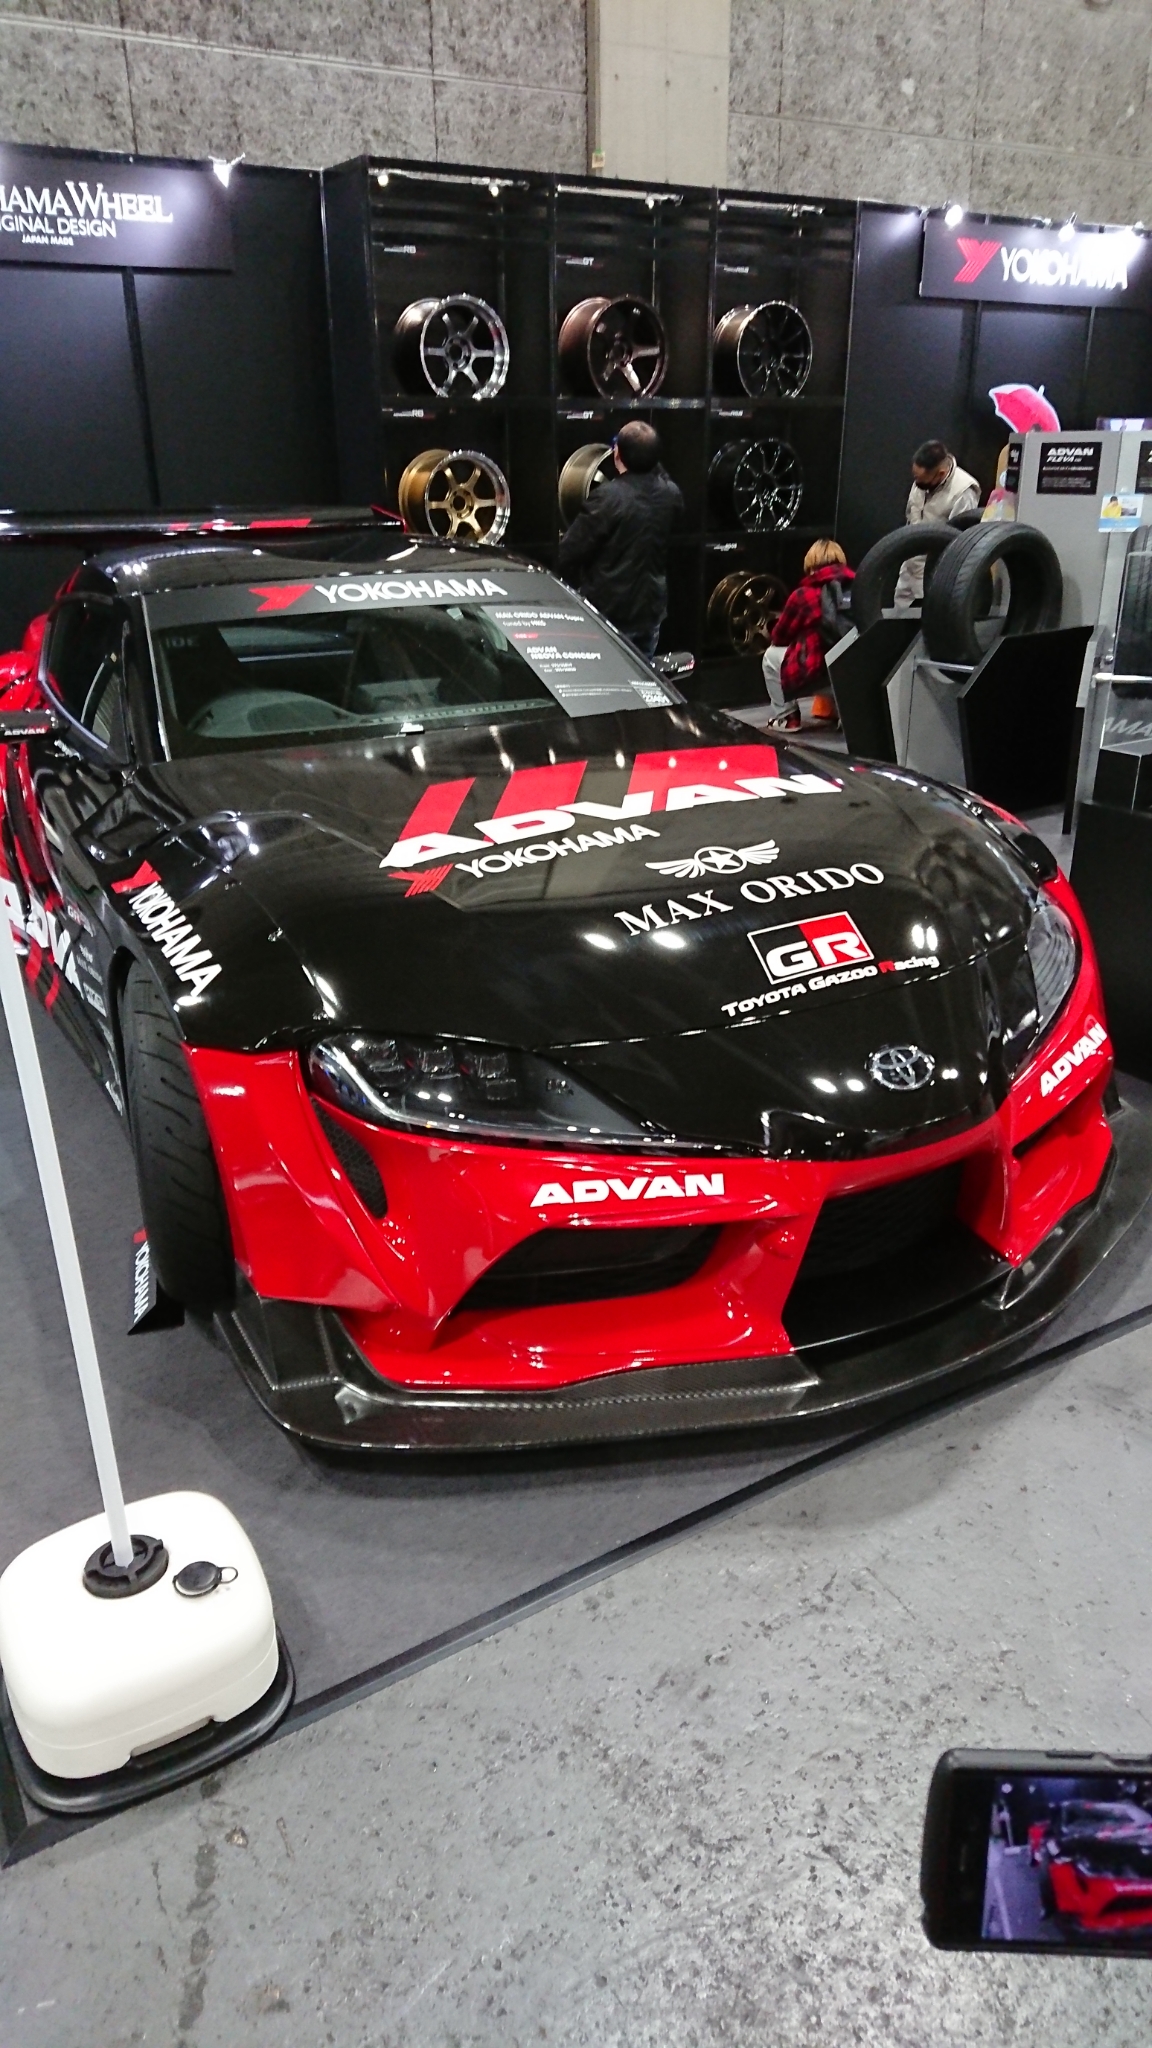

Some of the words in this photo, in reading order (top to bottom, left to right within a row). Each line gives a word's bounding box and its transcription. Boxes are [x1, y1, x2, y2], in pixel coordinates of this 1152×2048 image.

[0, 214, 54, 235] GINAL
[57, 217, 117, 238] DESIGN
[22, 234, 49, 245] JAPAN
[1000, 246, 1128, 290] YOKOHAMA
[1047, 447, 1094, 456] ADVAN
[314, 578, 508, 604] YOKOHAMA
[4, 727, 46, 737] ADVAN
[379, 773, 843, 869] ADVAN
[454, 823, 661, 879] YOKOHAMA
[614, 889, 734, 937] MAX
[740, 863, 885, 904] ORIDO
[128, 881, 223, 998] YOKOHAMA
[765, 931, 869, 978] GR
[720, 983, 808, 1018] TOYOTA
[807, 965, 878, 991] GAZOO
[878, 955, 940, 975] Racing
[1040, 1022, 1108, 1098] ADVAN
[529, 1172, 725, 1208] ADVAN
[133, 1240, 150, 1324] YOKOHAMA
